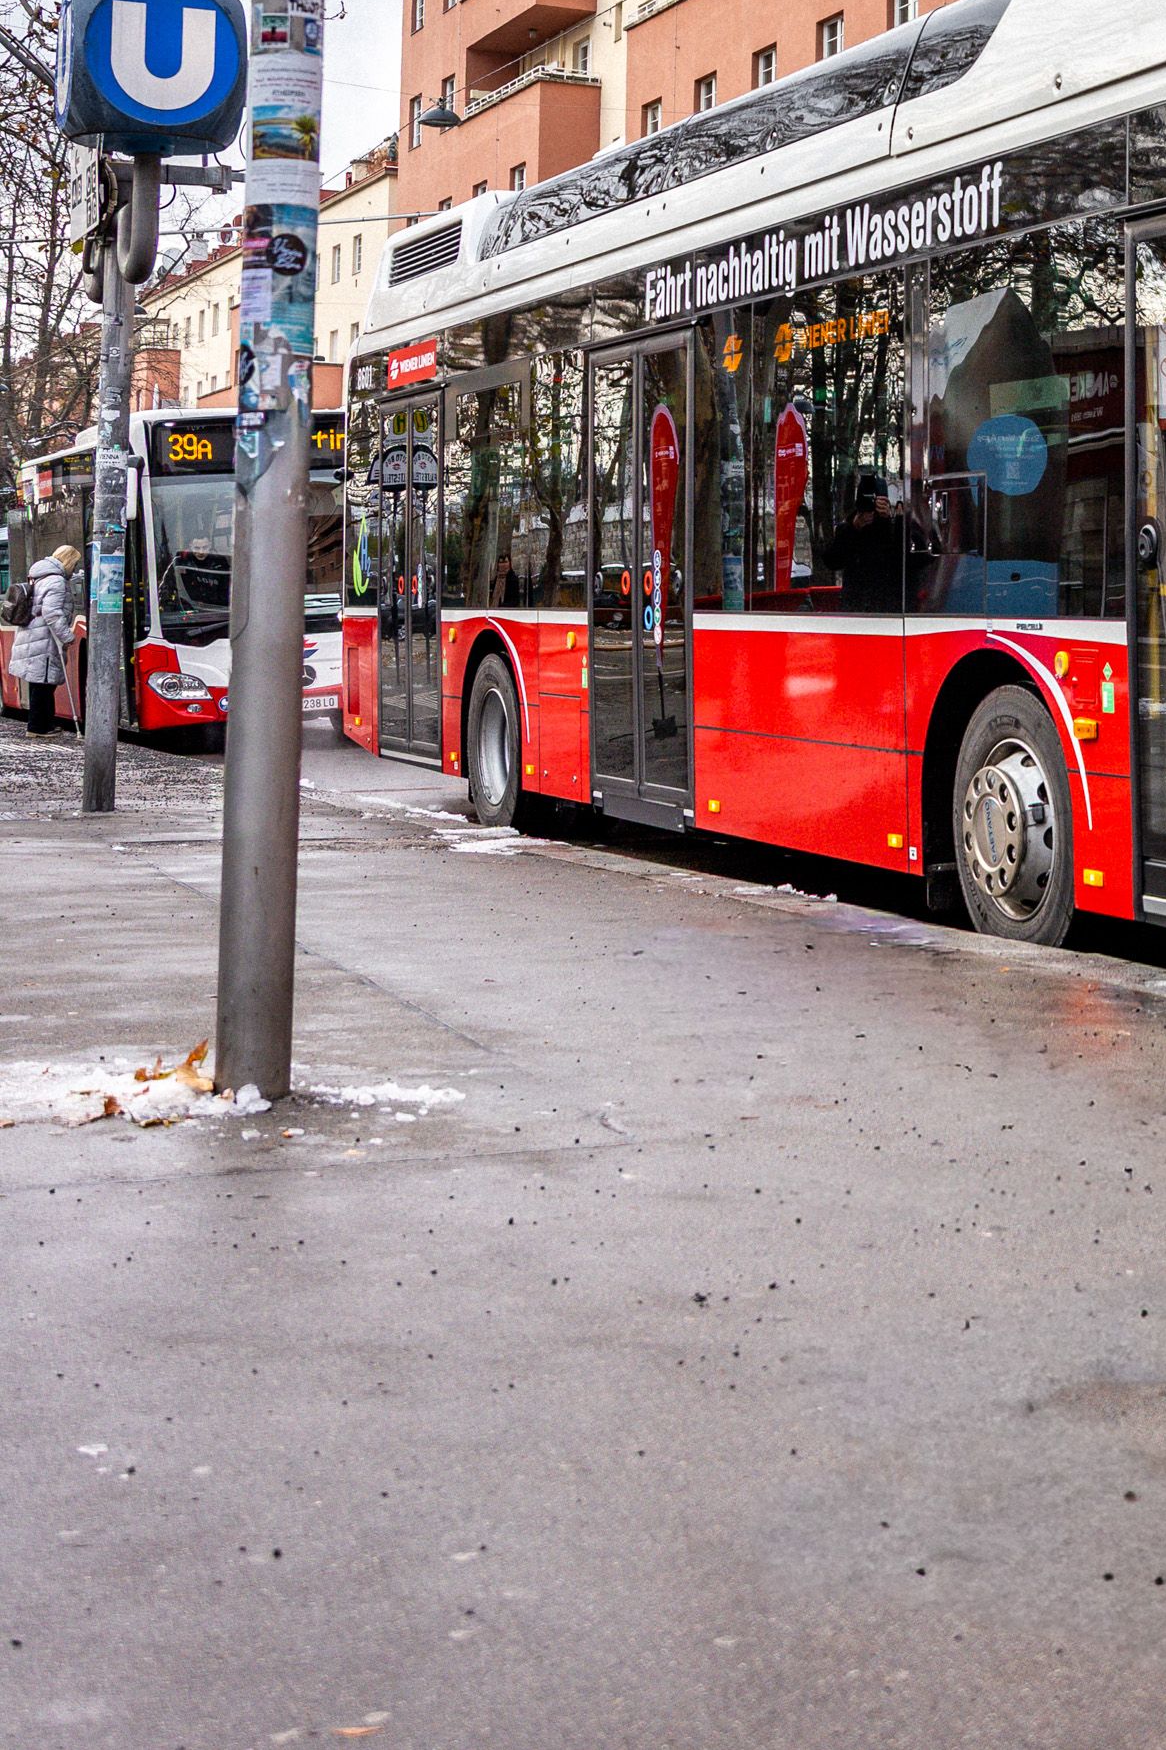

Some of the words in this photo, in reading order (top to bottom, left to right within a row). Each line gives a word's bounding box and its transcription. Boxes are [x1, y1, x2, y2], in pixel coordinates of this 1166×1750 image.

[110, 0, 217, 111] U
[645, 260, 692, 321] Fährt
[696, 229, 797, 298] nachhaltig
[804, 213, 840, 280] mit
[846, 161, 1004, 266] Wasserstoff
[399, 357, 418, 374] WIENER
[419, 352, 435, 369] LINIEN
[357, 365, 373, 390] 8601
[169, 433, 213, 461] 39A
[303, 697, 321, 709] 238
[984, 801, 997, 863] CAETANO
